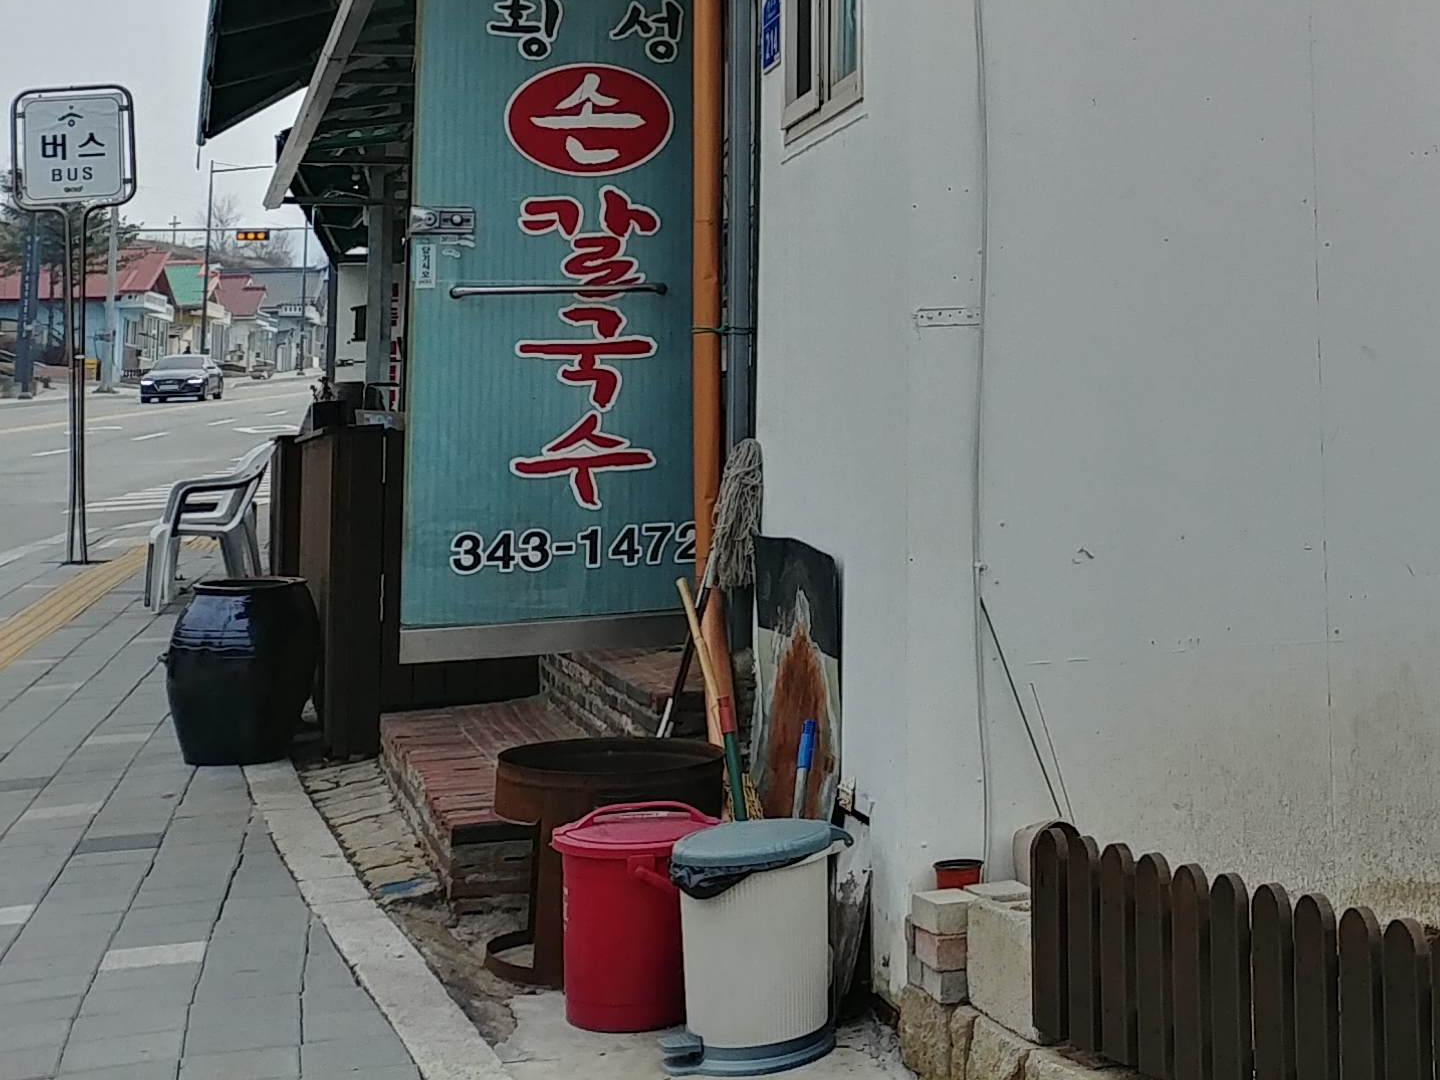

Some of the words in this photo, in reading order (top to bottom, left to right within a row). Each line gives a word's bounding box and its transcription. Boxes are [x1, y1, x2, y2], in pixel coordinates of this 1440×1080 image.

[41, 132, 105, 160] 버스
[52, 166, 93, 182] BUS
[421, 246, 431, 279] 당기시오
[451, 522, 696, 575] 343-1472
